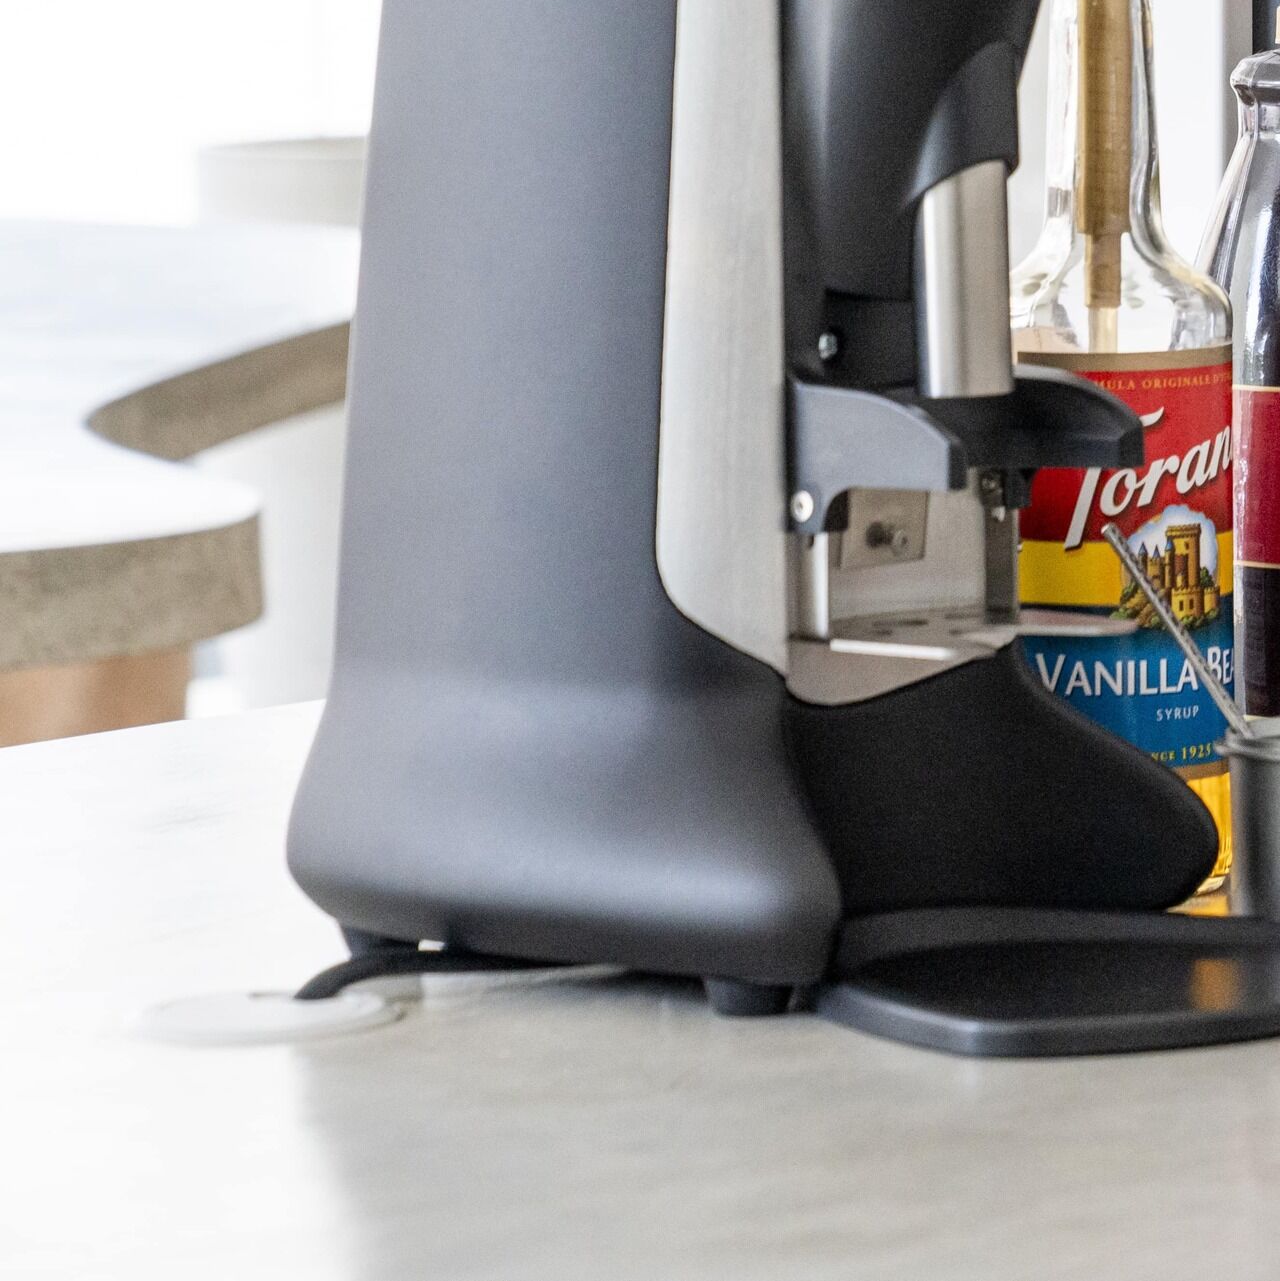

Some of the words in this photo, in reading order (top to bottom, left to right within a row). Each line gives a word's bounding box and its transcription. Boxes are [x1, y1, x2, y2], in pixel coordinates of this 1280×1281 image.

[1064, 406, 1233, 551] Toran
[1035, 652, 1199, 697] VANILLA
[1207, 645, 1234, 685] BE
[1156, 704, 1200, 722] SYRUP
[1151, 750, 1176, 762] NCE
[1182, 742, 1212, 761] 1925
